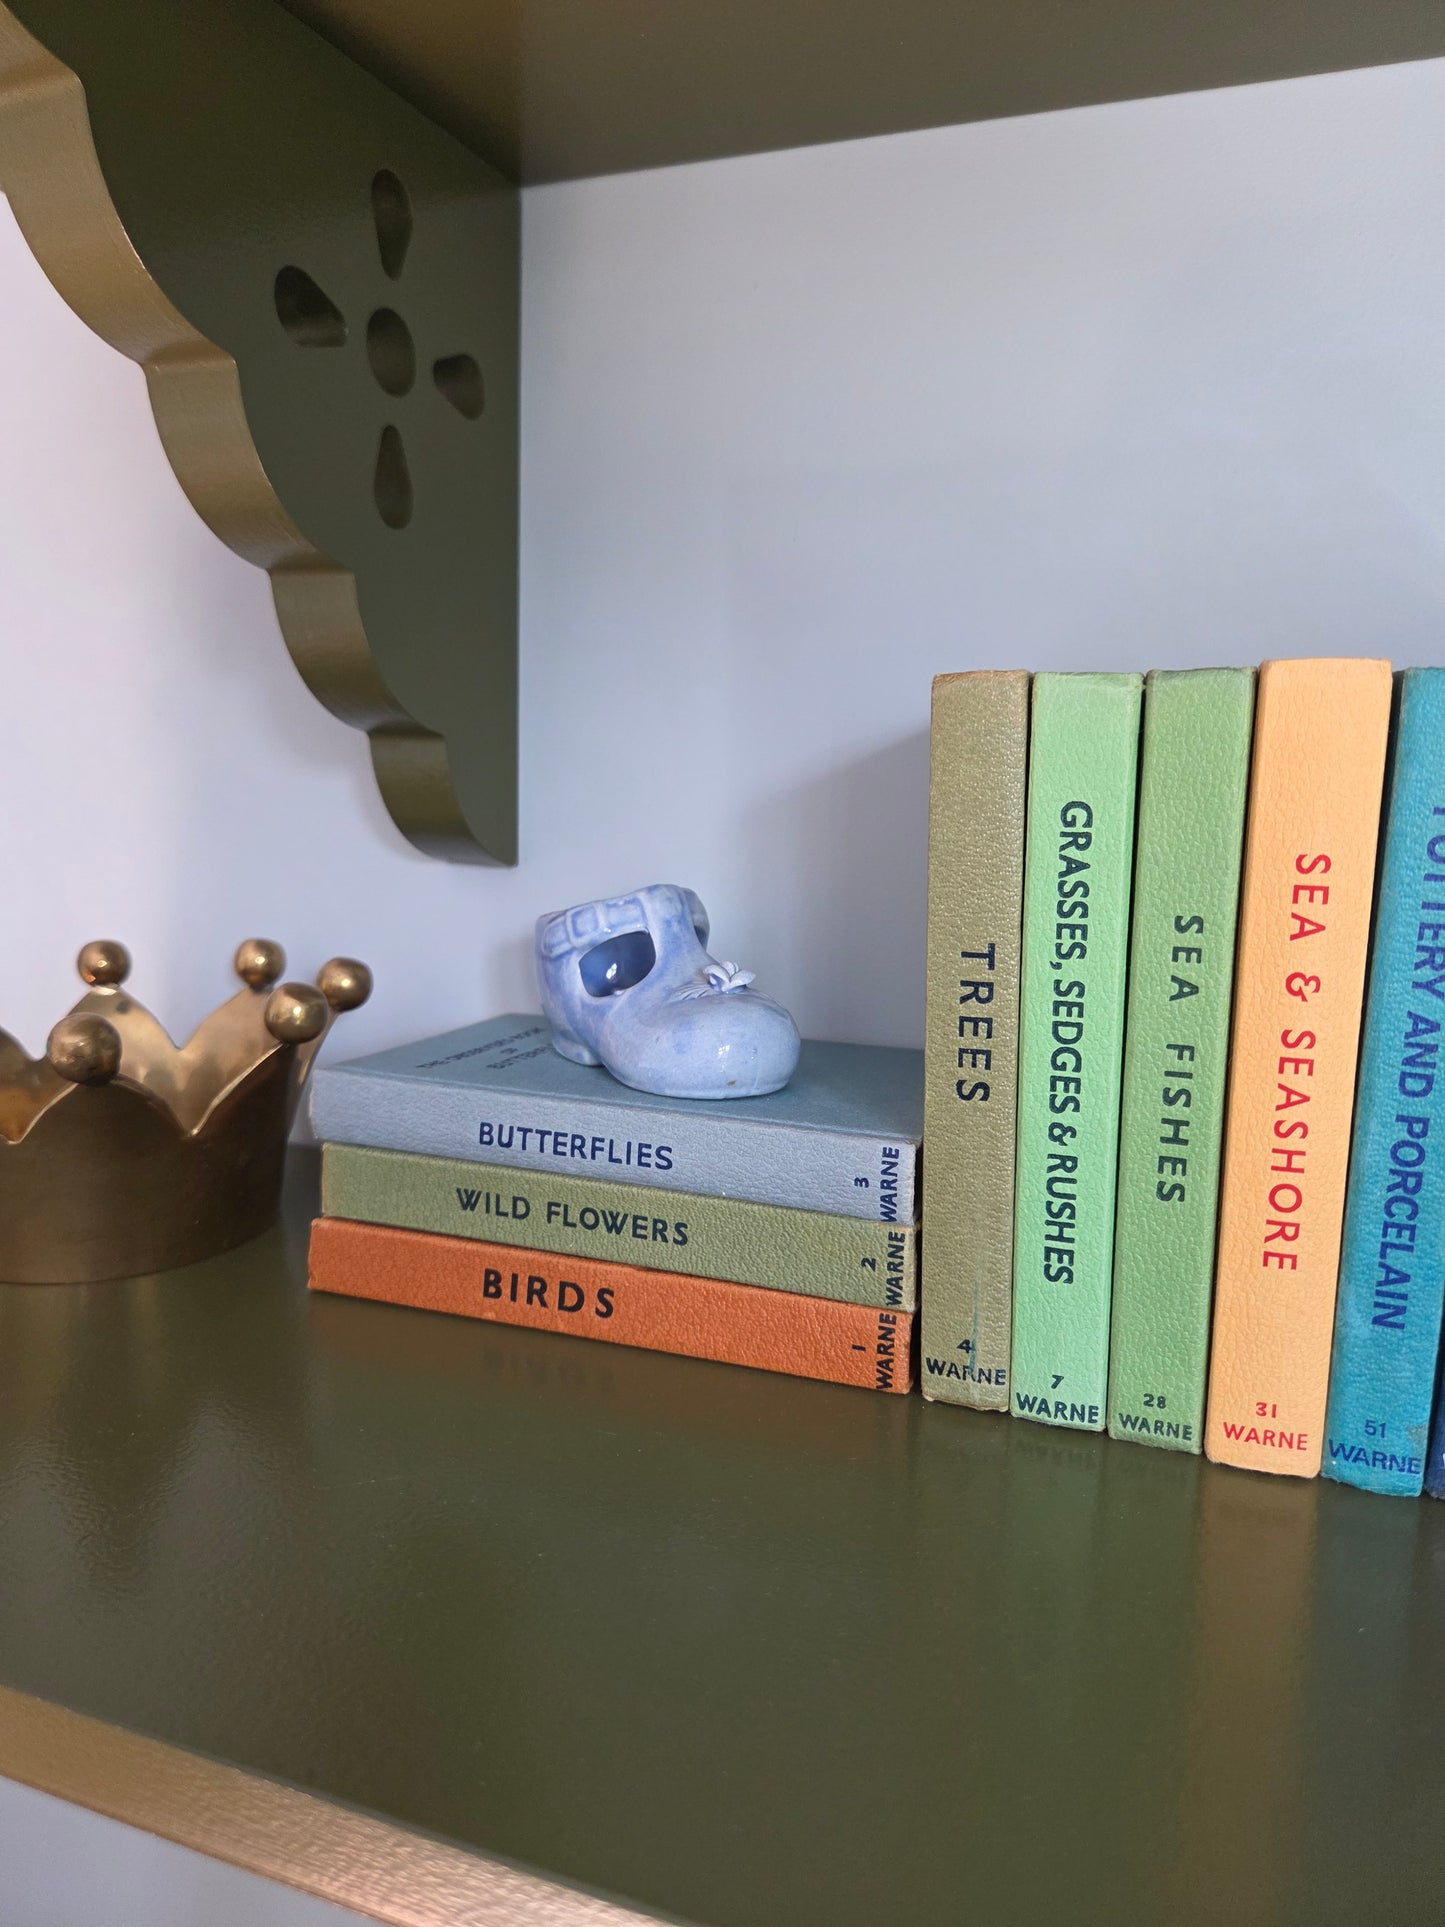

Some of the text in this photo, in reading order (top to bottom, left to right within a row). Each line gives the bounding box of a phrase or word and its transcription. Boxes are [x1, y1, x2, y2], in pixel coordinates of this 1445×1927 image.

[956, 943, 995, 1102] TREES
[1043, 800, 1093, 1286] GRASSES, SEDGES & RUSHES
[1155, 914, 1204, 1204] SEA FISHES
[1262, 853, 1332, 1272] SEA & SEASHORE
[1397, 1010, 1441, 1100] AND
[479, 1121, 673, 1170] BUTTERFLIES
[854, 1177, 869, 1188] 3
[880, 1146, 899, 1222] WARNE
[457, 1188, 689, 1246] WILD FLOWERS
[1371, 1114, 1430, 1332] PORCELAIN
[861, 1257, 876, 1271] 2
[886, 1231, 905, 1306] WARNE
[483, 1268, 615, 1318] BIRDS
[876, 1312, 897, 1390] WARNE
[956, 1338, 975, 1354] 4
[925, 1357, 1007, 1386] WARNE
[1051, 1374, 1064, 1389] 7
[1016, 1392, 1099, 1424] WARNE
[1143, 1393, 1166, 1409] 28
[1255, 1401, 1277, 1418] 31
[1119, 1412, 1192, 1441] WARNE
[1223, 1421, 1308, 1451] WARNE
[1364, 1419, 1386, 1438] 51
[1328, 1439, 1421, 1475] WARNE
